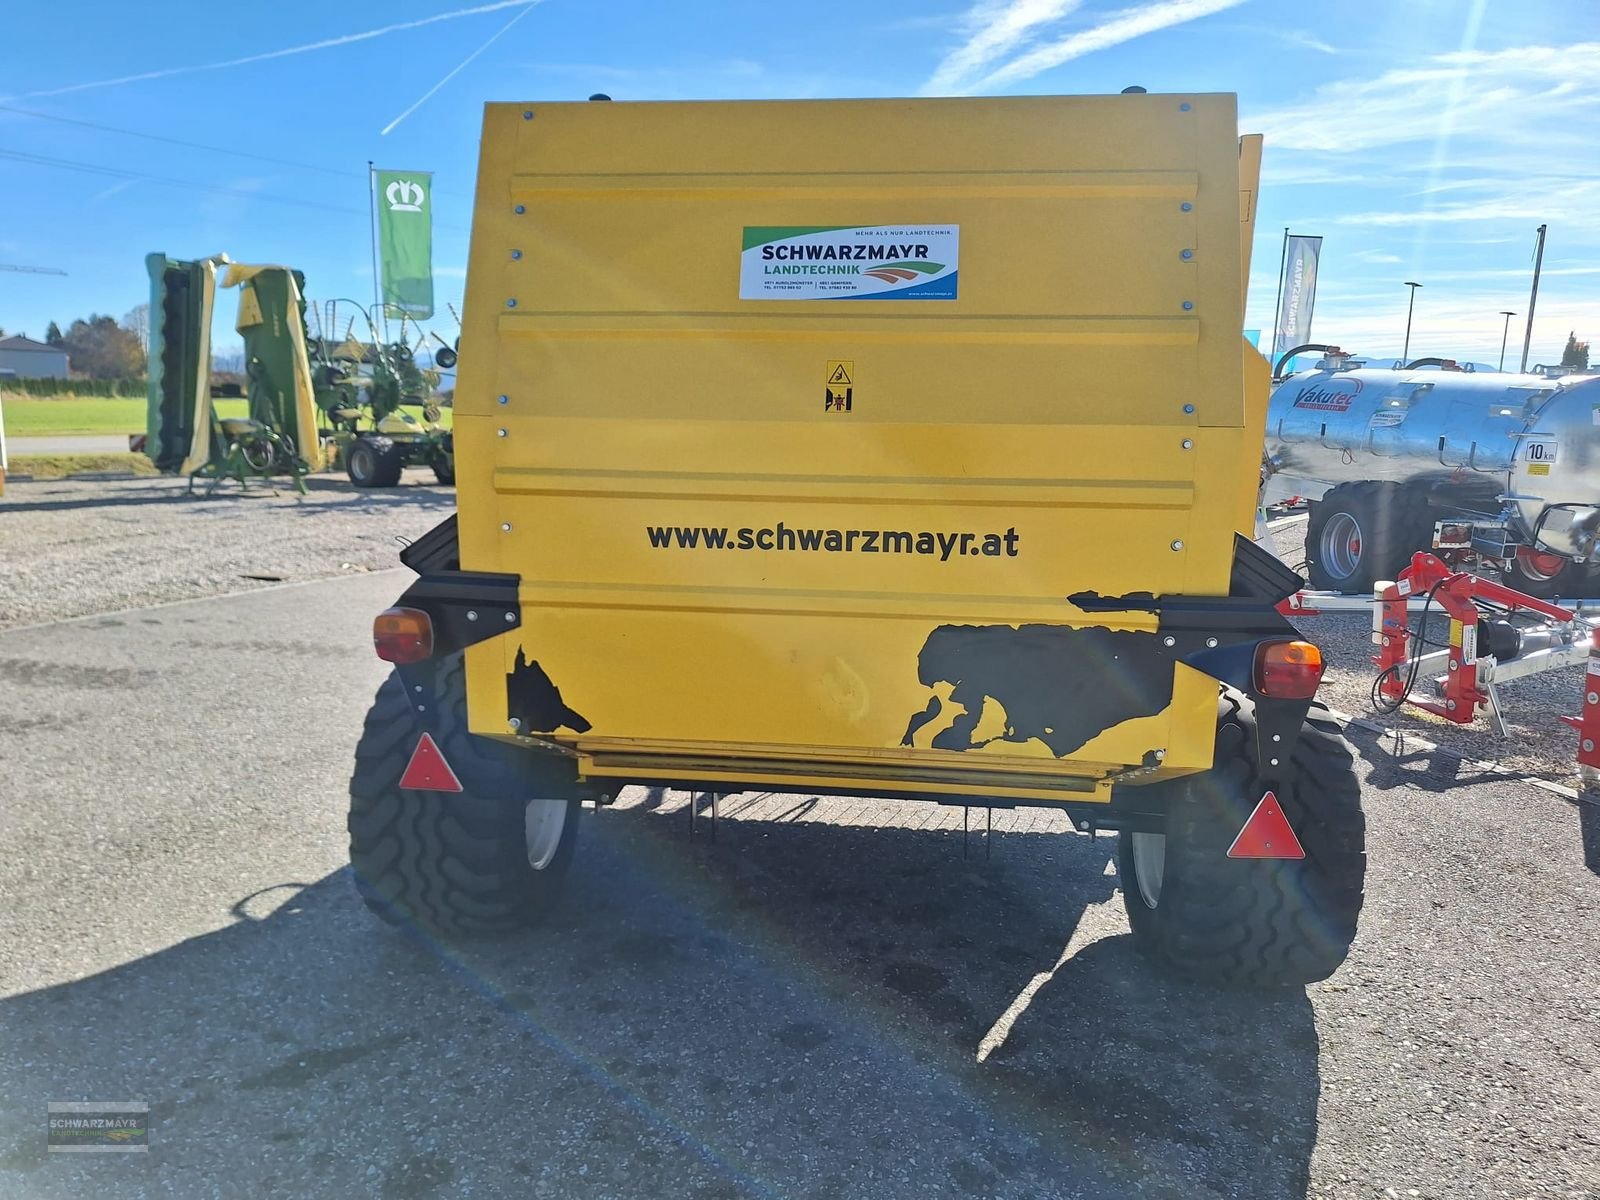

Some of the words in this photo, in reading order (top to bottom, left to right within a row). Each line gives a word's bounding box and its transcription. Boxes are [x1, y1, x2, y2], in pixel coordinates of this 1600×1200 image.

[762, 245, 928, 260] SCHWARZMAYR
[764, 265, 860, 275] LANDTECHNIK
[1287, 259, 1303, 337] SCHWARZMAYR
[1293, 384, 1357, 407] Vakutec
[1529, 444, 1544, 459] 10
[1543, 451, 1555, 460] km
[646, 522, 1019, 561] www.schwarzmayr.at
